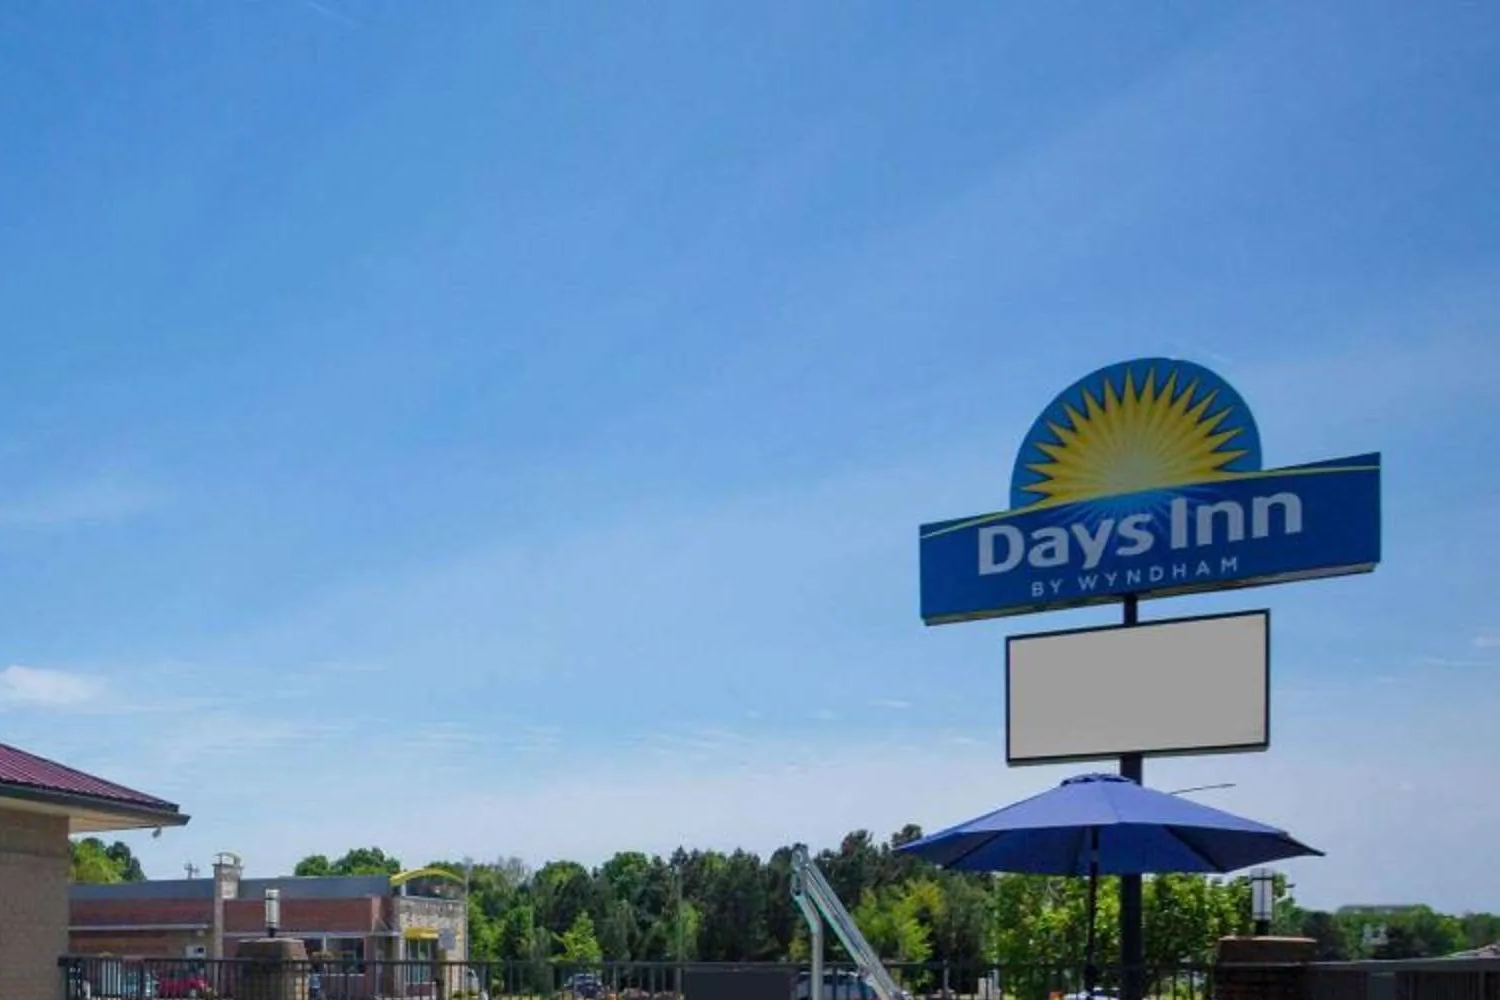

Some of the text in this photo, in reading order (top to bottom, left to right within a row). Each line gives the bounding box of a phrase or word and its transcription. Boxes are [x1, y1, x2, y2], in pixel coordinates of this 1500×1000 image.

[978, 492, 1303, 576] Days Inn
[1031, 557, 1239, 597] BY WYNDHAM
